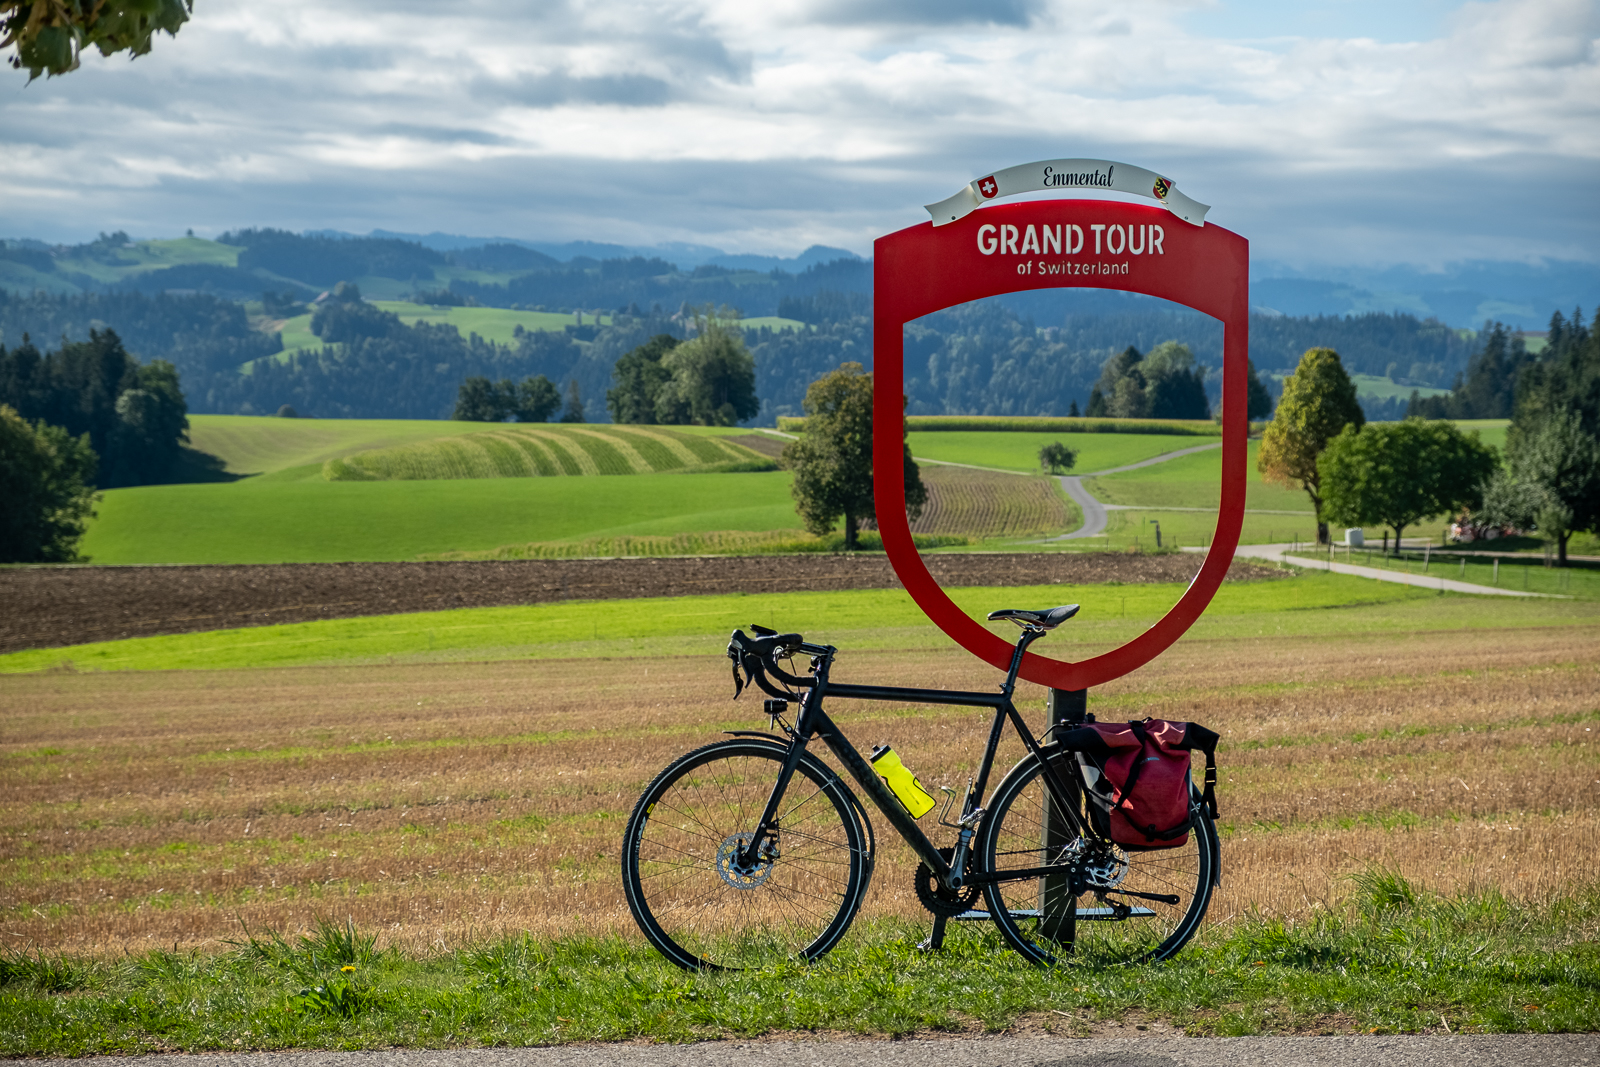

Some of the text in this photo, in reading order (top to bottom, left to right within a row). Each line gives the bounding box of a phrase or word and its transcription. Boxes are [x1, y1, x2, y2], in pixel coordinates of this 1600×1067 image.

[1043, 165, 1114, 188] Emmental
[977, 224, 1165, 255] GRAND TOUR
[1016, 260, 1129, 275] of Switzerland
